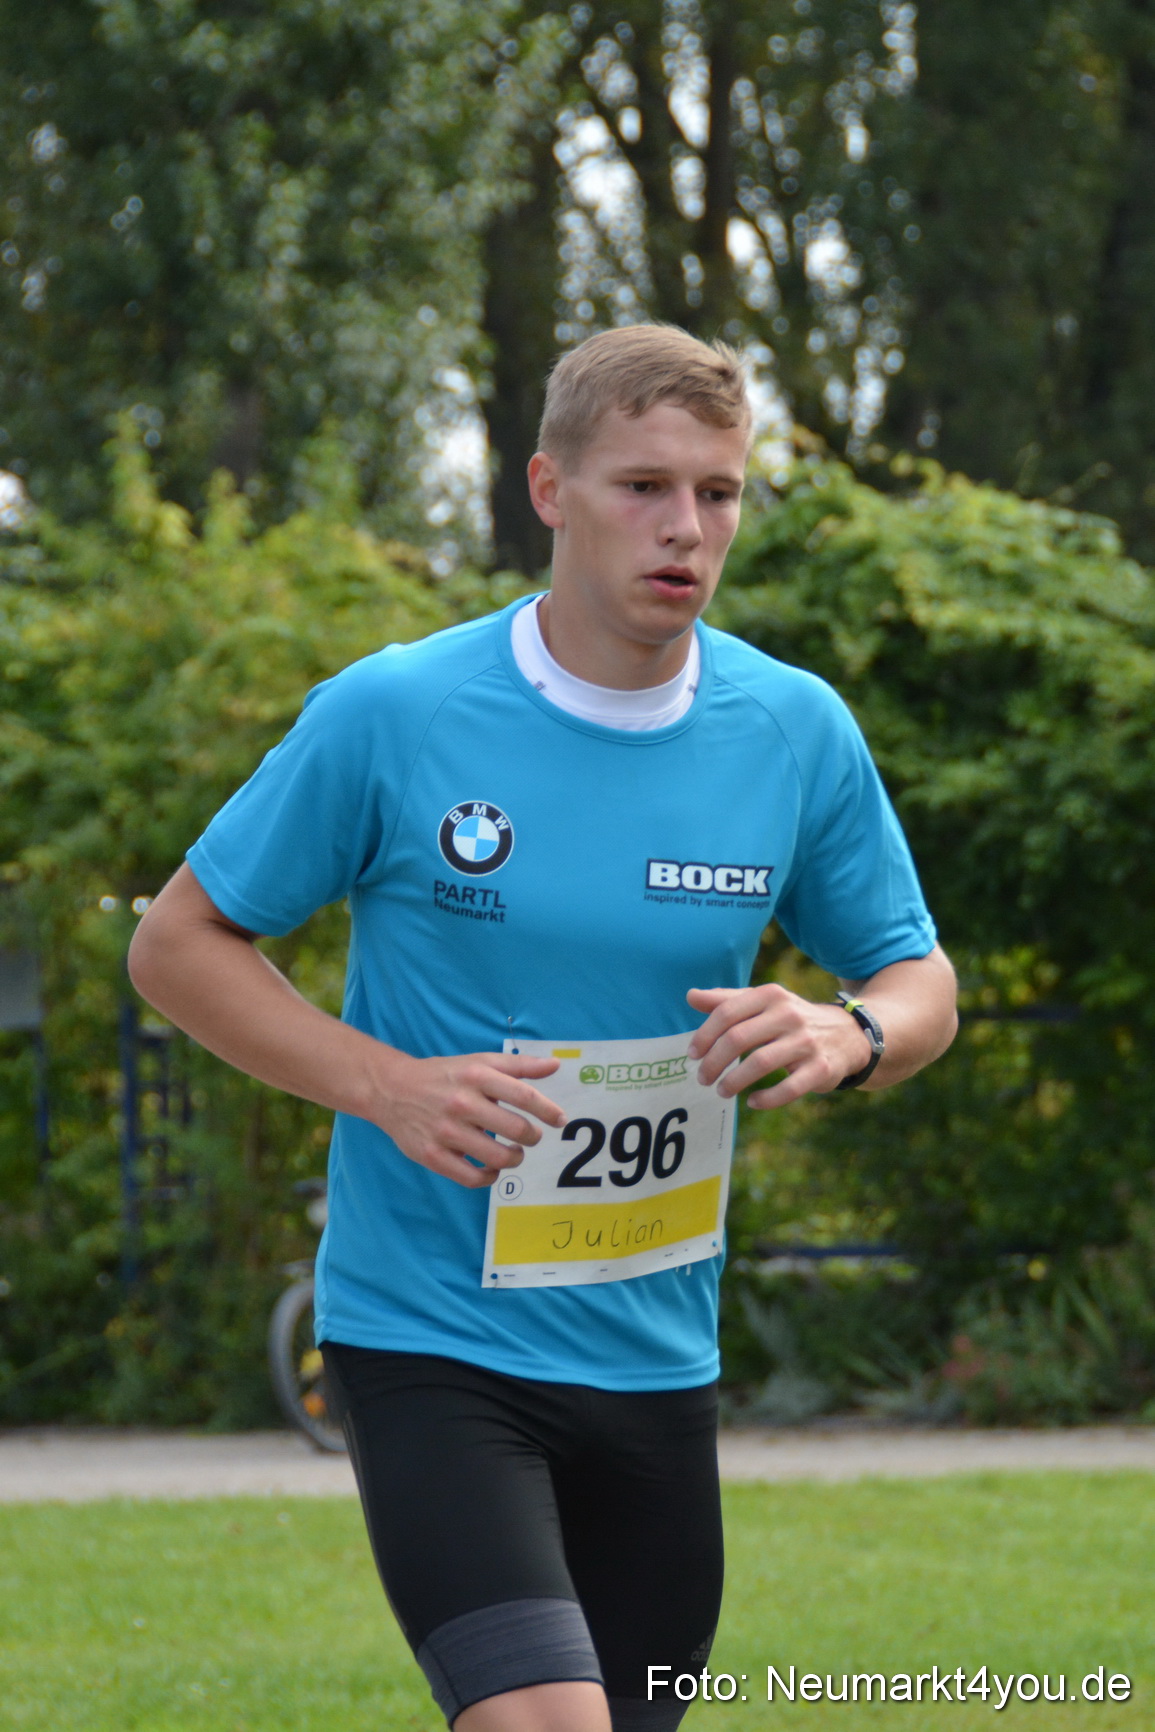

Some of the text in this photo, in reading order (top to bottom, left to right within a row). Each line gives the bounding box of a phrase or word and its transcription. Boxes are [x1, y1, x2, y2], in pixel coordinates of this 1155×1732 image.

[448, 803, 509, 831] BMW
[646, 858, 774, 897] BOCK
[433, 880, 507, 909] PARTL
[644, 892, 687, 905] inspired
[690, 896, 702, 907] by
[705, 897, 734, 908] smart
[434, 898, 505, 923] Neumarkt
[606, 1056, 688, 1084] BOCK
[556, 1107, 689, 1188] 296
[505, 1181, 515, 1195] D
[552, 1218, 664, 1250] Julian
